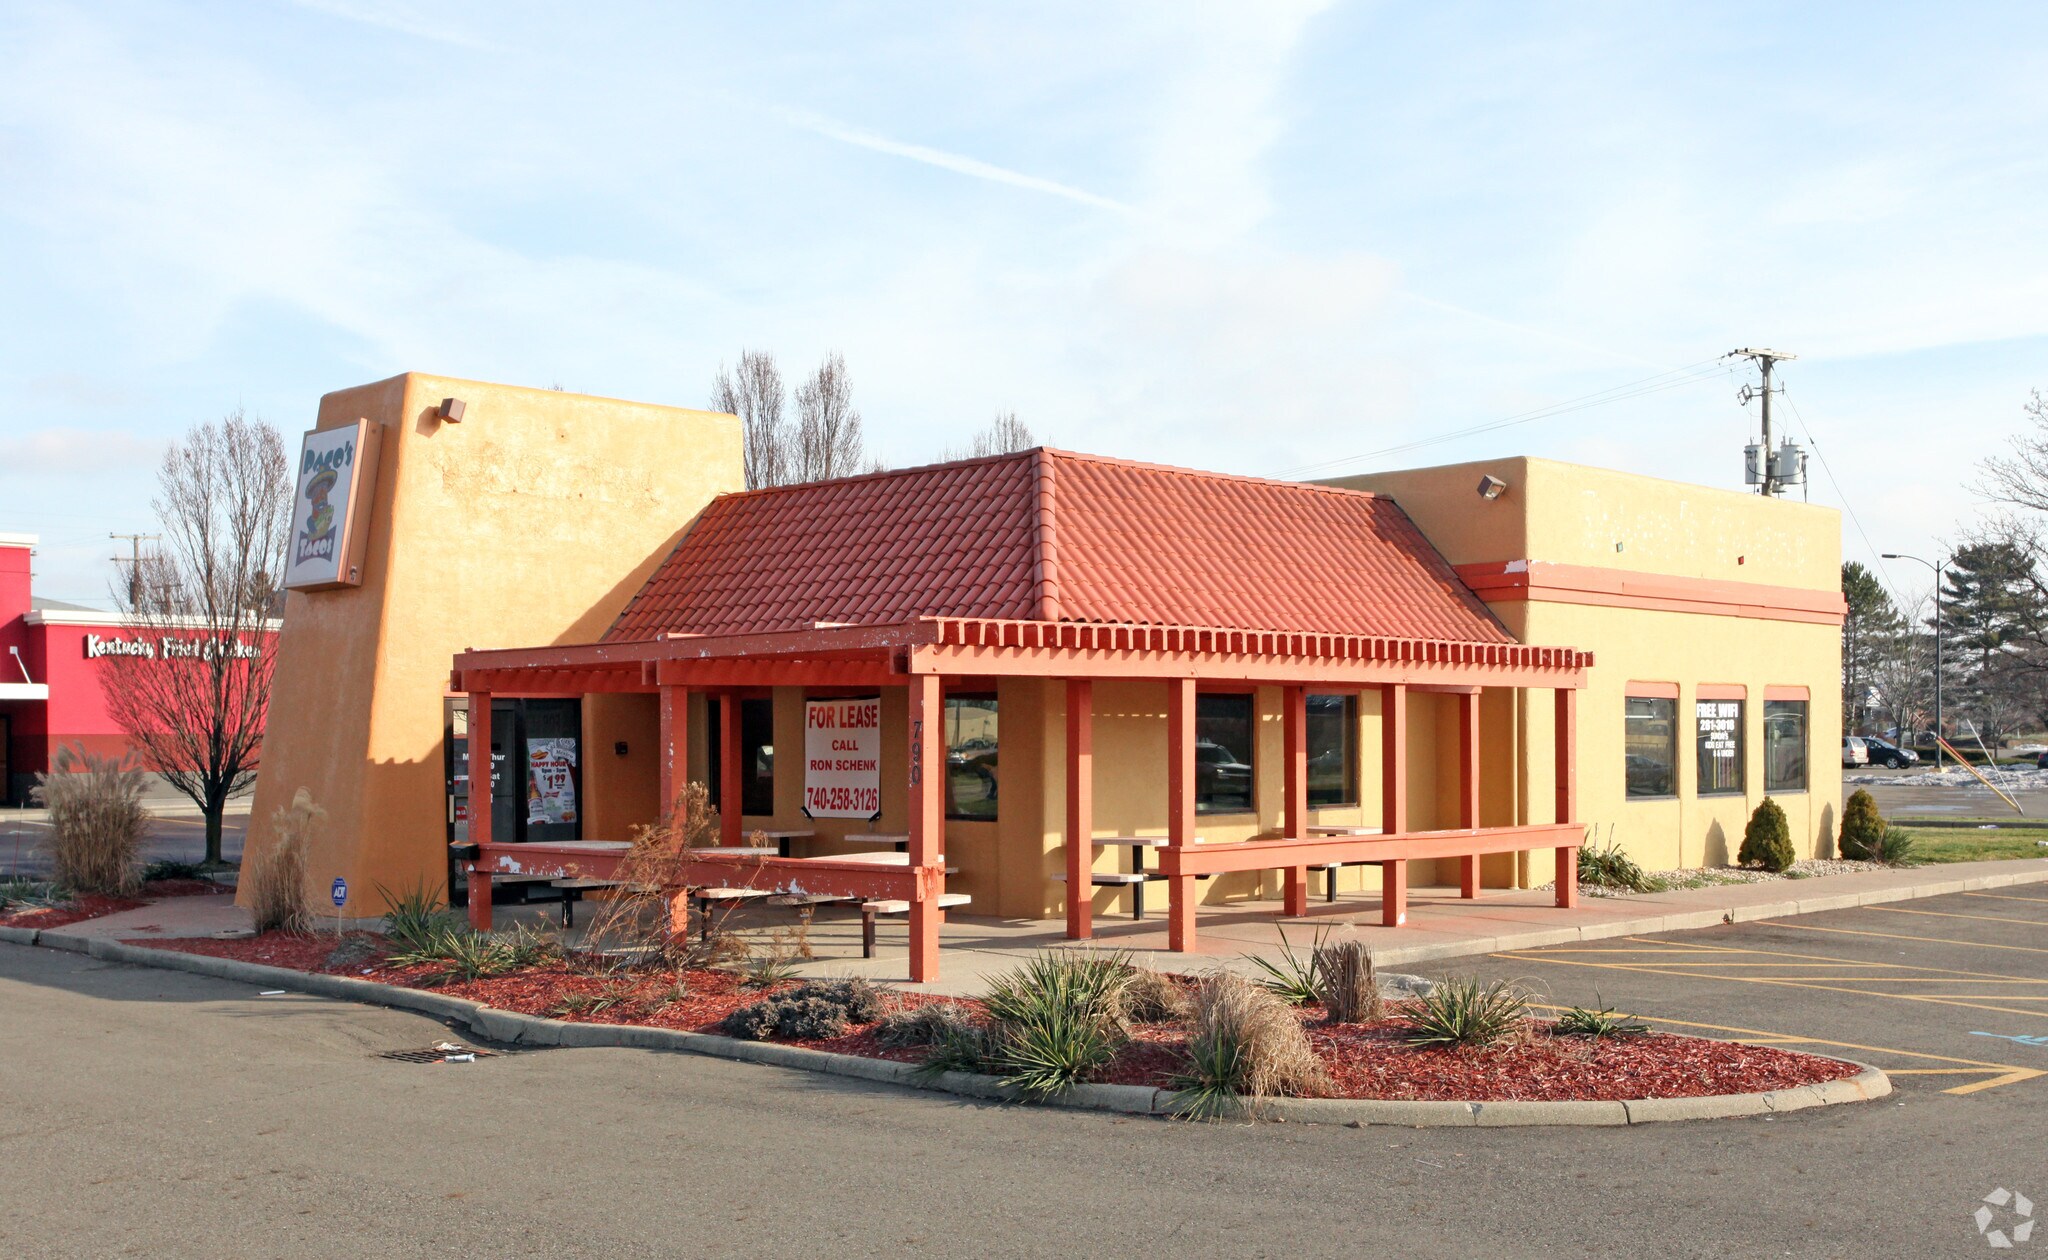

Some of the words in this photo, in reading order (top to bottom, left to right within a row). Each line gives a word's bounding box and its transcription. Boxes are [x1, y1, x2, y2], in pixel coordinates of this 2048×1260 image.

[87, 633, 154, 658] Kentucky
[809, 706, 835, 729] FOR
[840, 705, 877, 728] LEASE
[1696, 703, 1716, 718] FREE
[1718, 703, 1738, 718] WIFI
[832, 739, 859, 751] CALL
[911, 720, 922, 785] 790
[810, 760, 832, 771] RON
[835, 760, 877, 771] SCHENK
[807, 787, 877, 811] 740-258-3126
[333, 886, 346, 898] ADT
